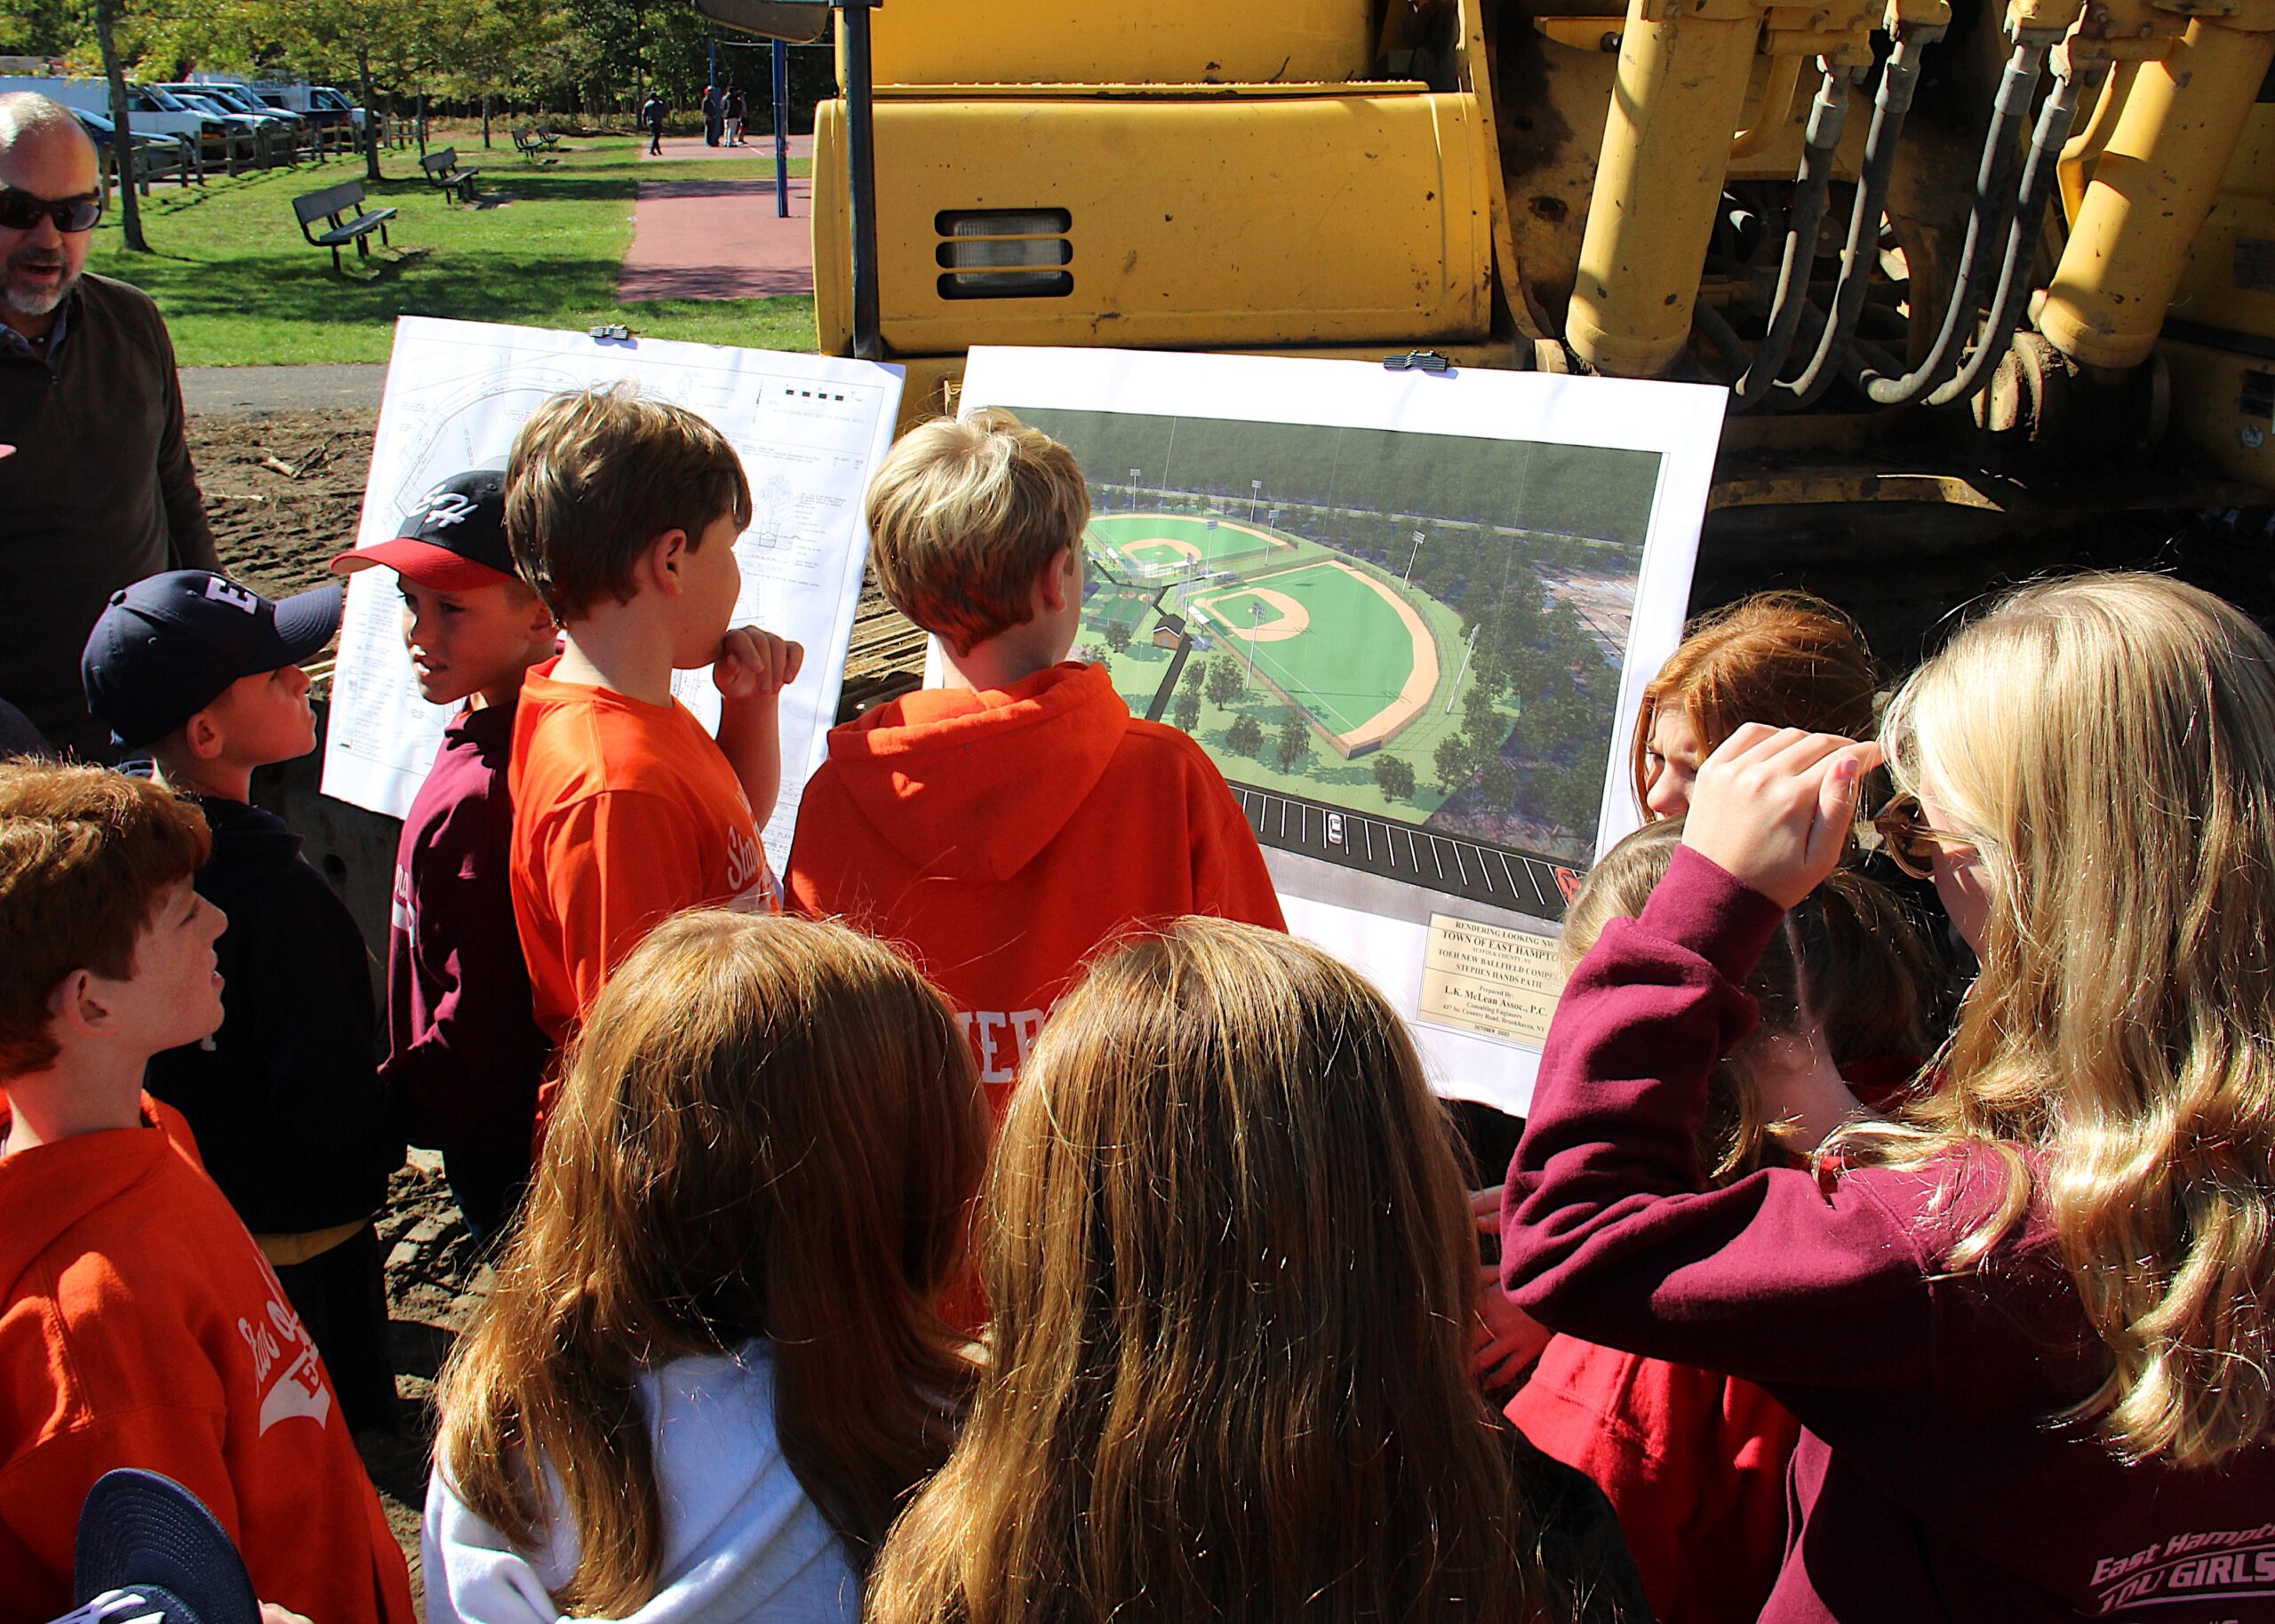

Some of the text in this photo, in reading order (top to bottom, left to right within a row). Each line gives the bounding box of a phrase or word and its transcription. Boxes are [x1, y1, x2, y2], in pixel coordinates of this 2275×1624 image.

[1443, 930, 1472, 943] TOWN
[1473, 937, 1487, 947] OF
[1489, 941, 1514, 952] EAST
[1456, 921, 1553, 948] RENDERING LOOKING NW
[1461, 953, 1478, 963] NEW
[1481, 958, 1524, 974] BALLFIELD
[1457, 963, 1543, 989] STEPHEN HANDS PATH
[1445, 985, 1548, 1017] L.K. McLean Assoc., P.C.
[1480, 985, 1504, 996] Prepared
[1462, 1008, 1483, 1019] Country
[1536, 1024, 1545, 1033] NY
[1466, 1001, 1522, 1020] Consulting Engineers
[1473, 1023, 1496, 1034] OCTOBER
[2089, 1543, 2162, 1587] East
